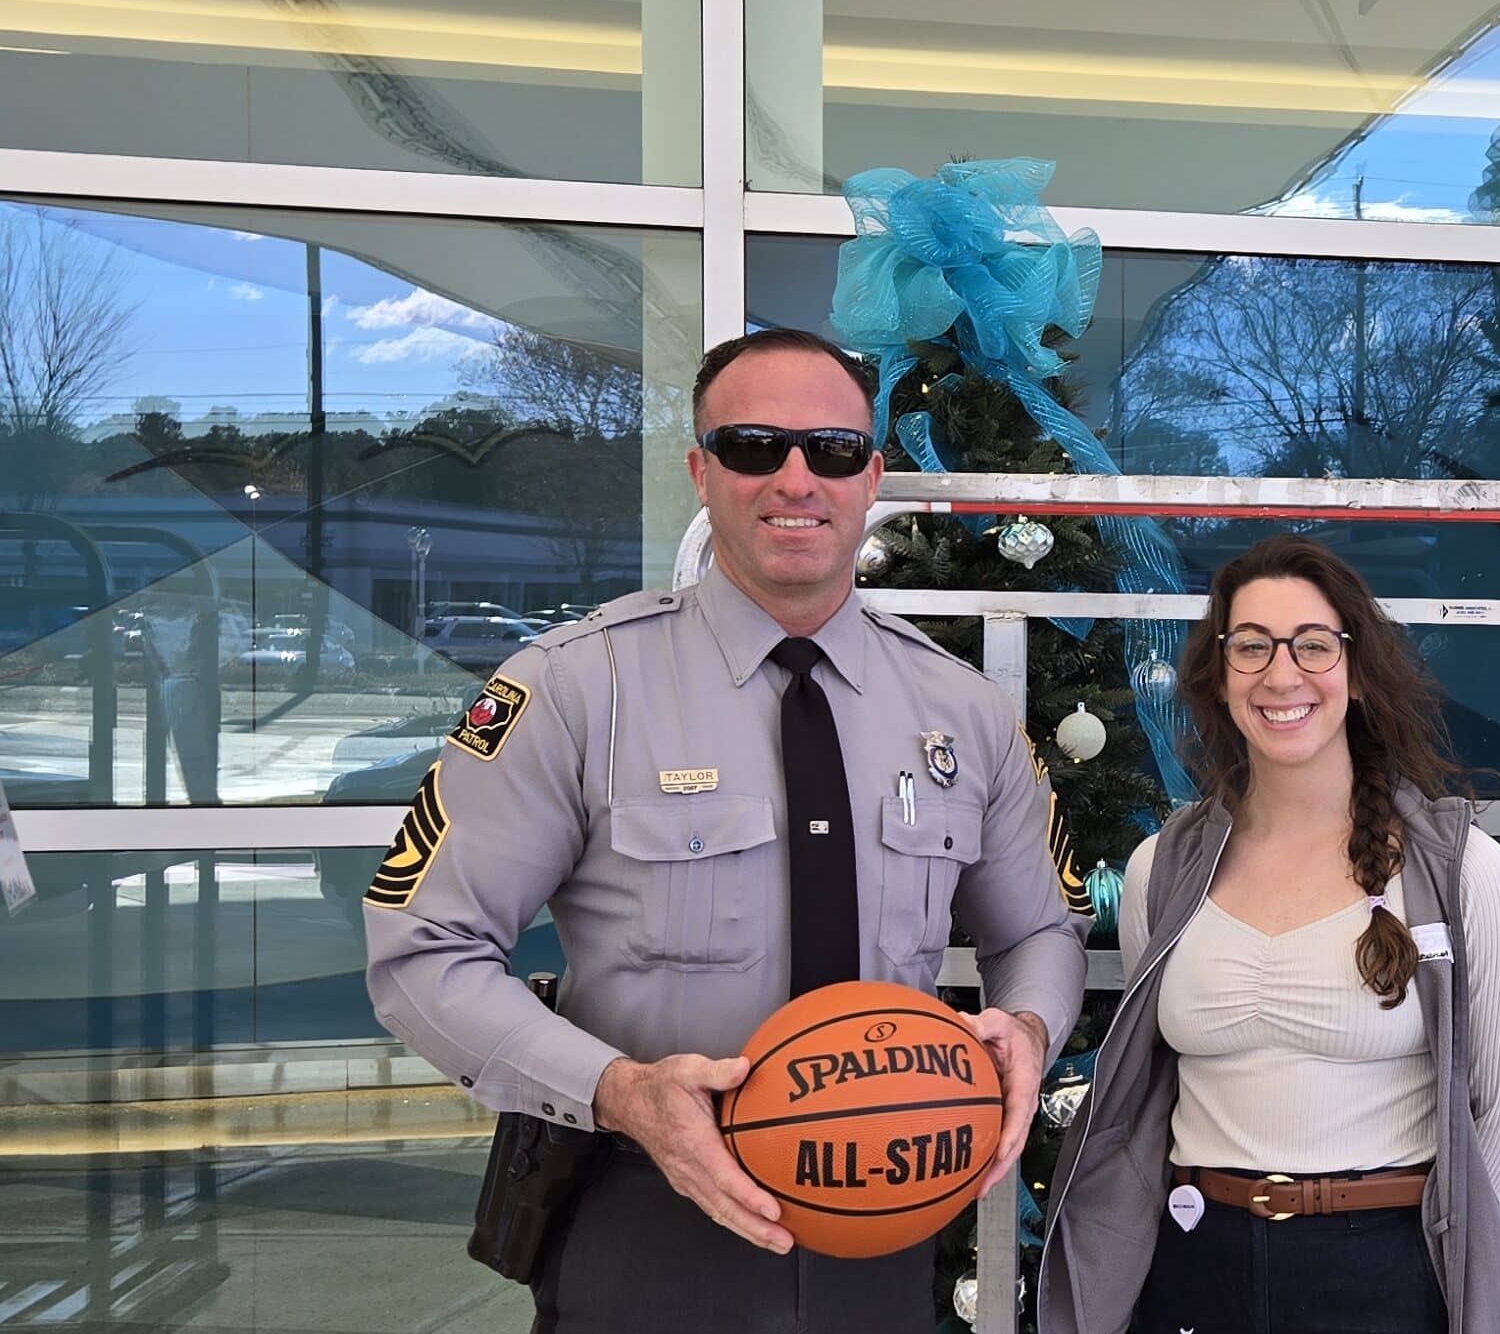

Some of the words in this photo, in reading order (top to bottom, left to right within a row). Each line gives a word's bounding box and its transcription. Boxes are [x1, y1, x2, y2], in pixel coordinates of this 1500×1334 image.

[458, 729, 490, 753] PATROL
[664, 771, 714, 782] TAYLOR
[787, 1044, 973, 1103] SPALDING
[795, 1123, 973, 1188] ALL-STAR
